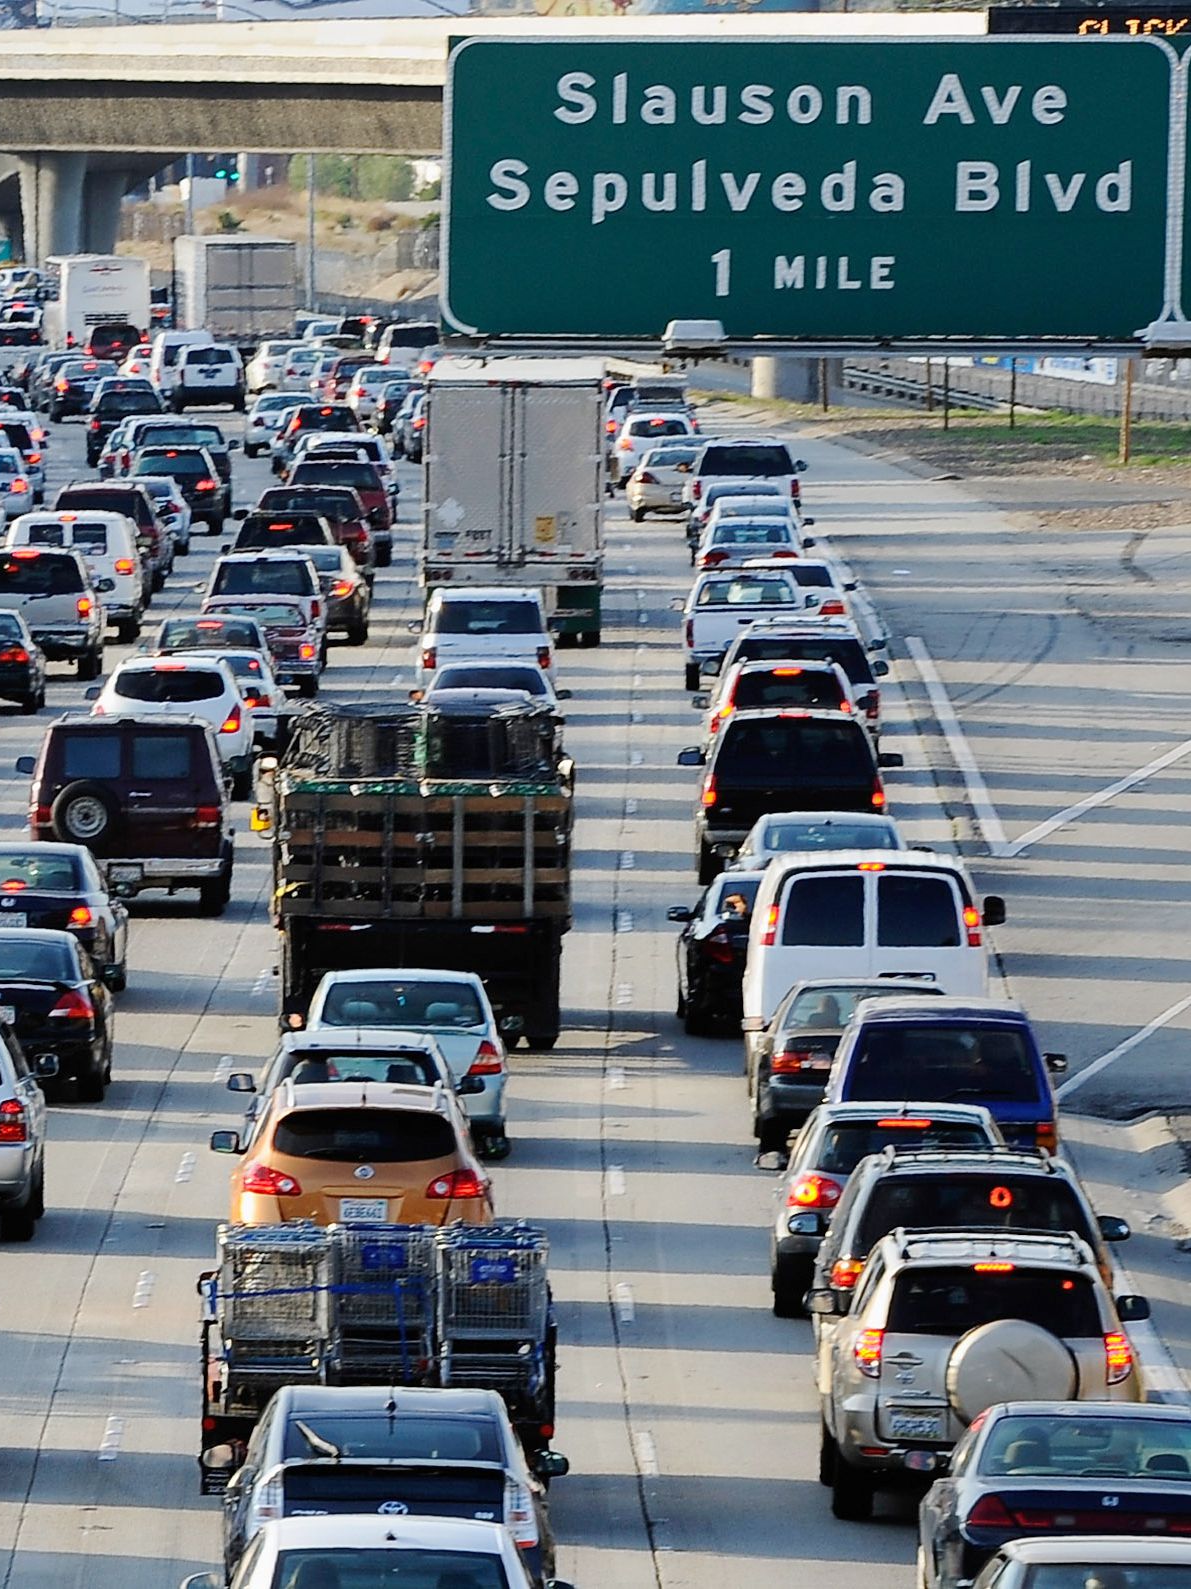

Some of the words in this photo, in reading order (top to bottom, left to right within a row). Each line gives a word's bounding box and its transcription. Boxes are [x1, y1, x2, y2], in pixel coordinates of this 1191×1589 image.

[553, 71, 872, 125] Slauson
[922, 73, 1068, 125] Ave
[486, 158, 905, 225] Sepulveda
[955, 159, 1132, 212] Blvd
[711, 248, 731, 297] 1
[774, 255, 896, 290] MILE
